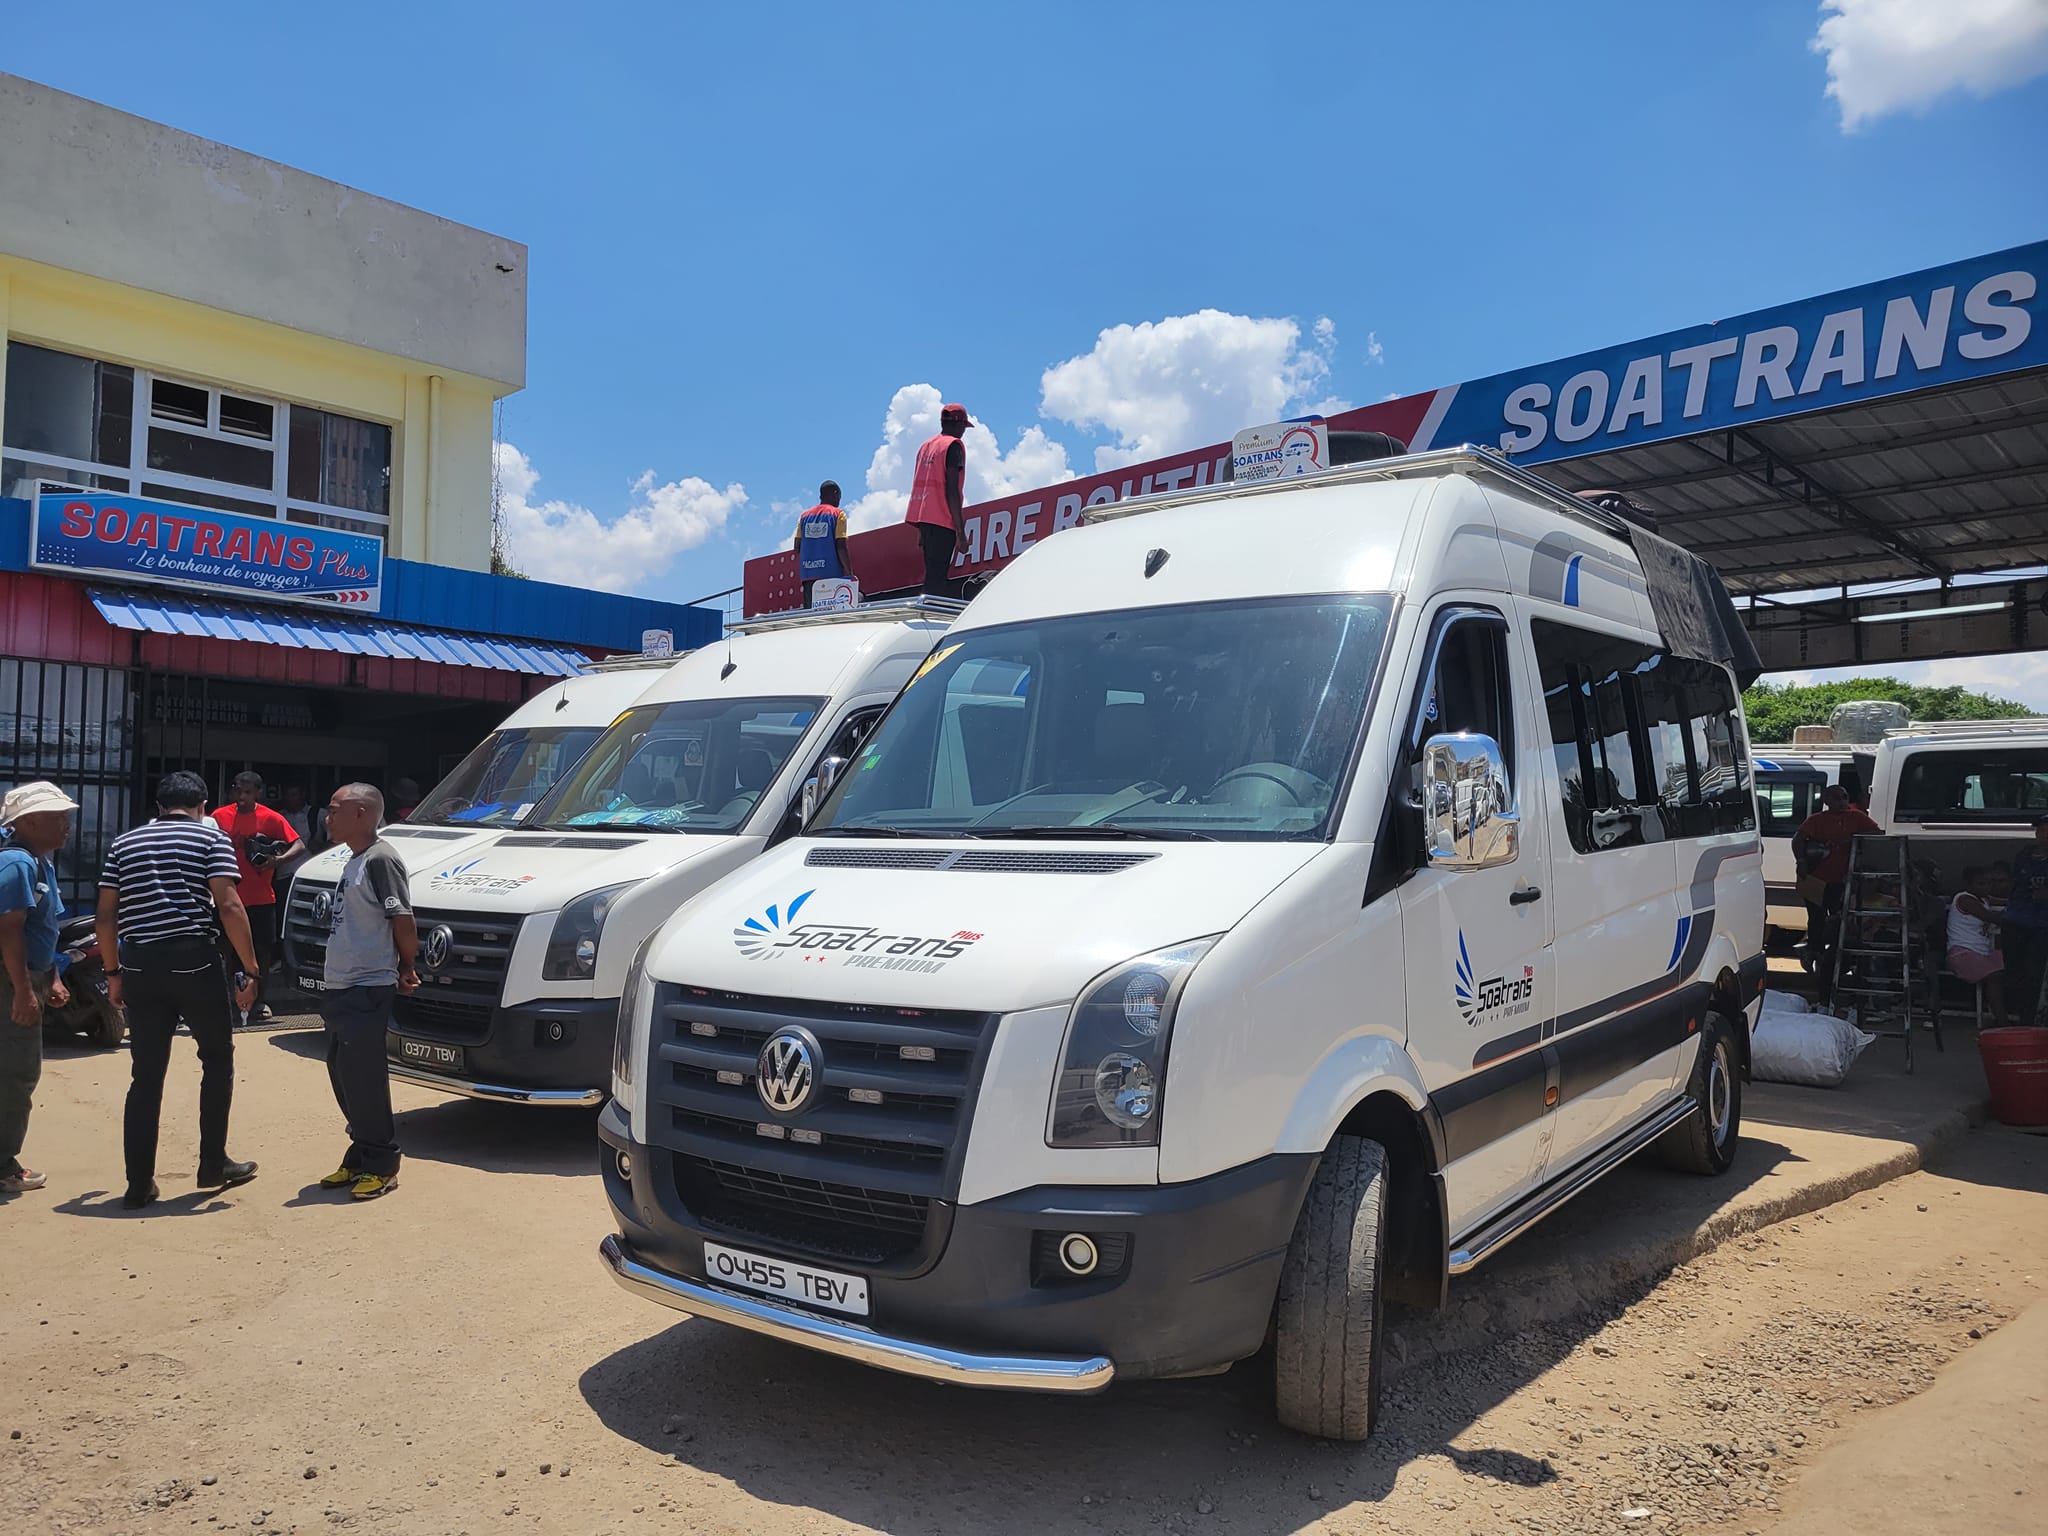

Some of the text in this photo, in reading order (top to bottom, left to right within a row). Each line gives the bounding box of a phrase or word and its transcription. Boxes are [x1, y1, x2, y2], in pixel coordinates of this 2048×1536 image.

[1500, 271, 2036, 454] SOATRANS
[1234, 449, 1283, 467] SOATRANS
[60, 502, 371, 580] SOATRANS Plus
[950, 502, 1042, 567] ARE
[158, 554, 221, 575] bonheur
[223, 564, 243, 579] de
[772, 924, 977, 959] Soatrans
[841, 954, 947, 975] PREMIUM
[1476, 976, 1533, 1014] Soatrans
[405, 1042, 456, 1063] 0377 TBV
[716, 1252, 848, 1304] 0455 TBV
